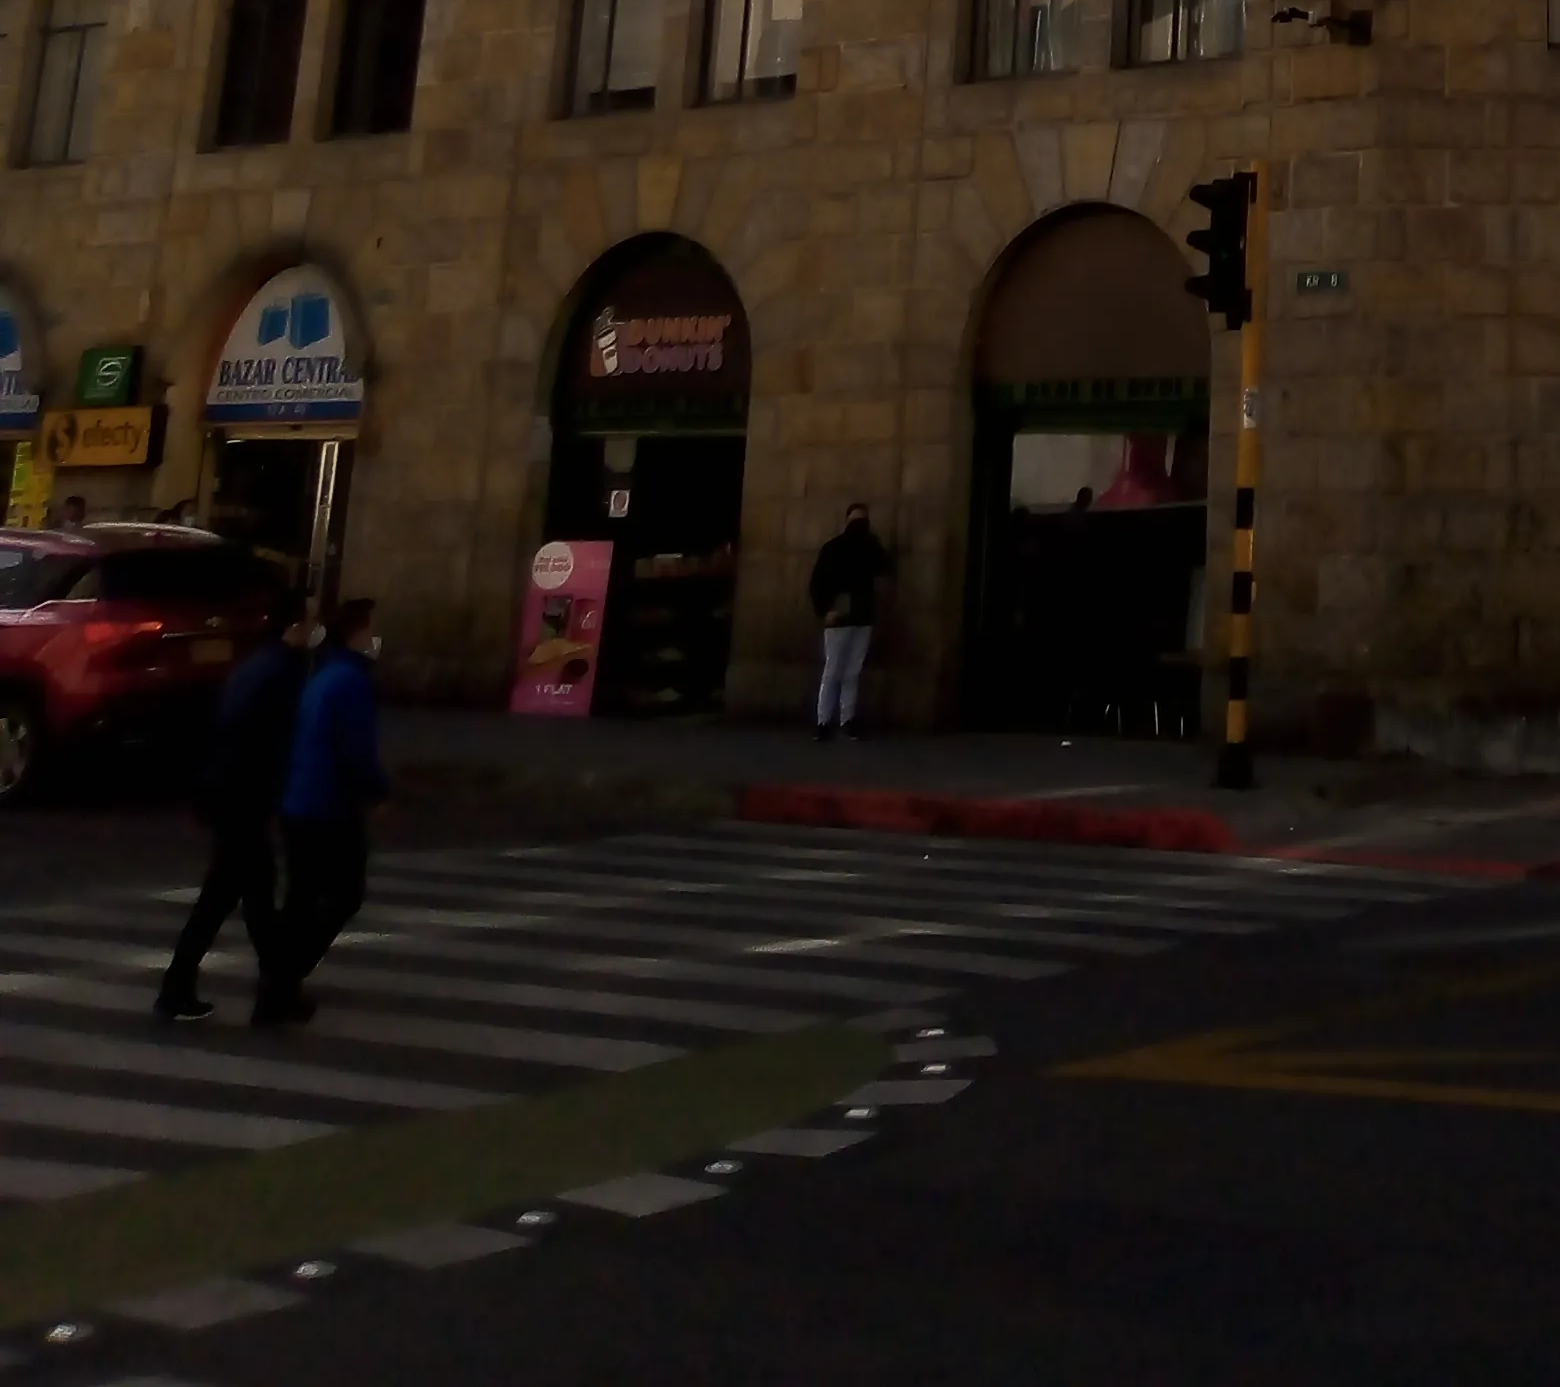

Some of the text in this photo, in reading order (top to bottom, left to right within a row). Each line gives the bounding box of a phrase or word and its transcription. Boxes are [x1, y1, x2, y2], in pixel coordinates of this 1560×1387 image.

[1306, 274, 1320, 288] KR
[623, 341, 724, 374] DONUTS
[217, 358, 276, 387] BAZAR
[216, 388, 272, 402] CENTRO
[82, 419, 144, 454] efecty
